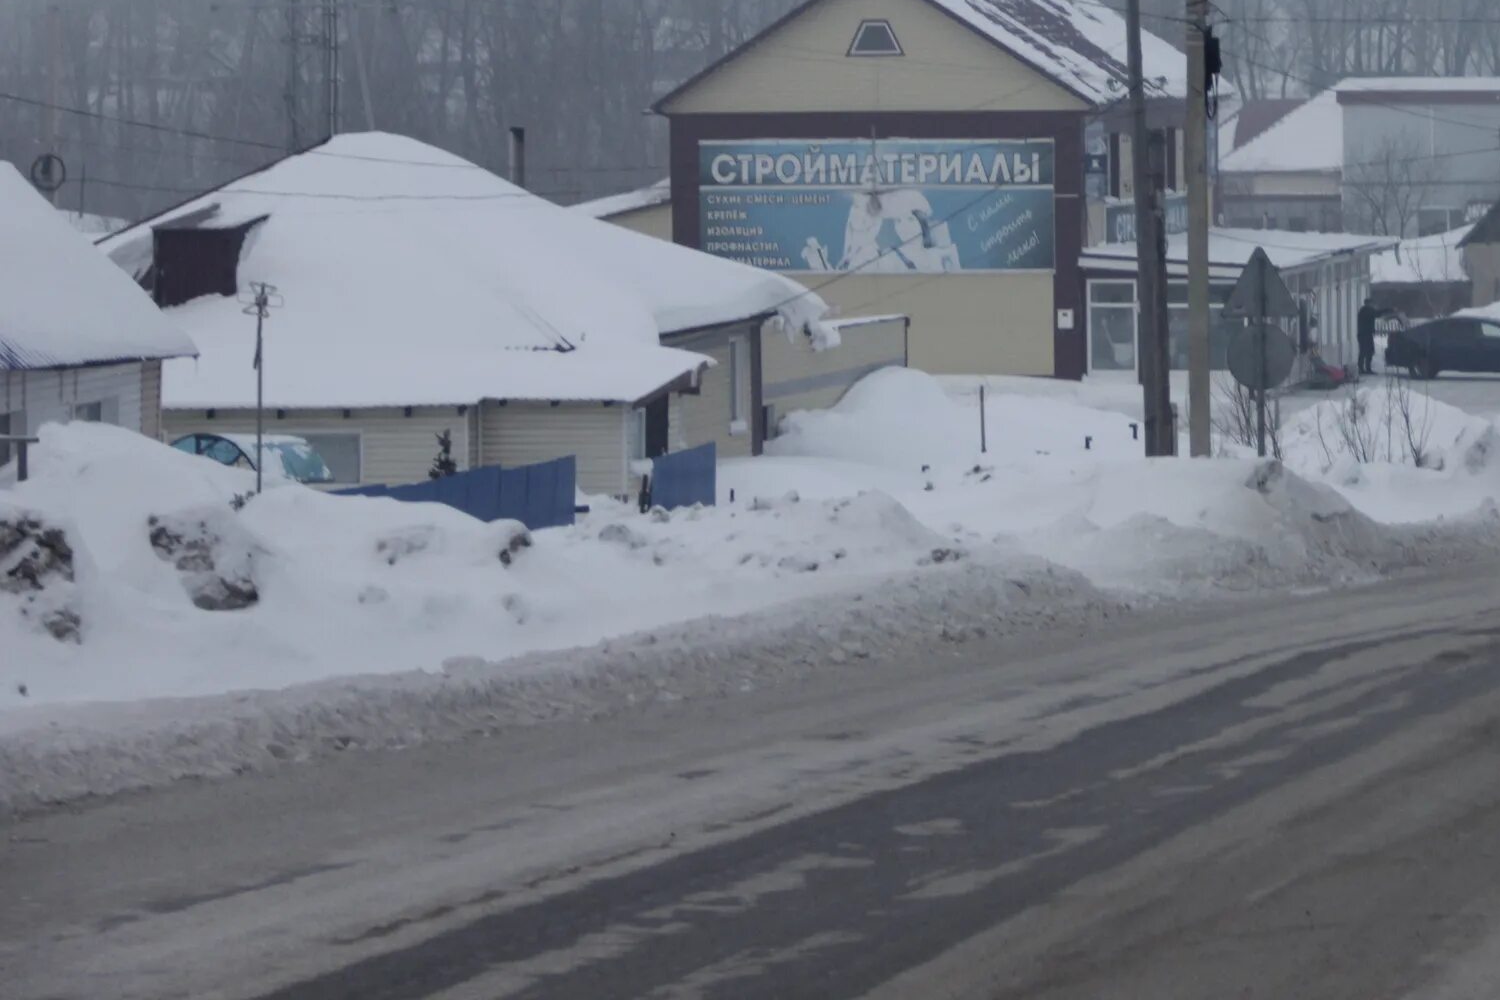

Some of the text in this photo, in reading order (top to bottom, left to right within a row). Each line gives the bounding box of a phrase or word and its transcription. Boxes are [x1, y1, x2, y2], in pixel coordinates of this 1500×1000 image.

[711, 145, 1040, 184] СТРОЙМАТЕРИАЛЫ
[706, 226, 764, 236] ИЗОЛЯЦИЯ
[706, 242, 780, 252] ПРОФНАСТИЛ
